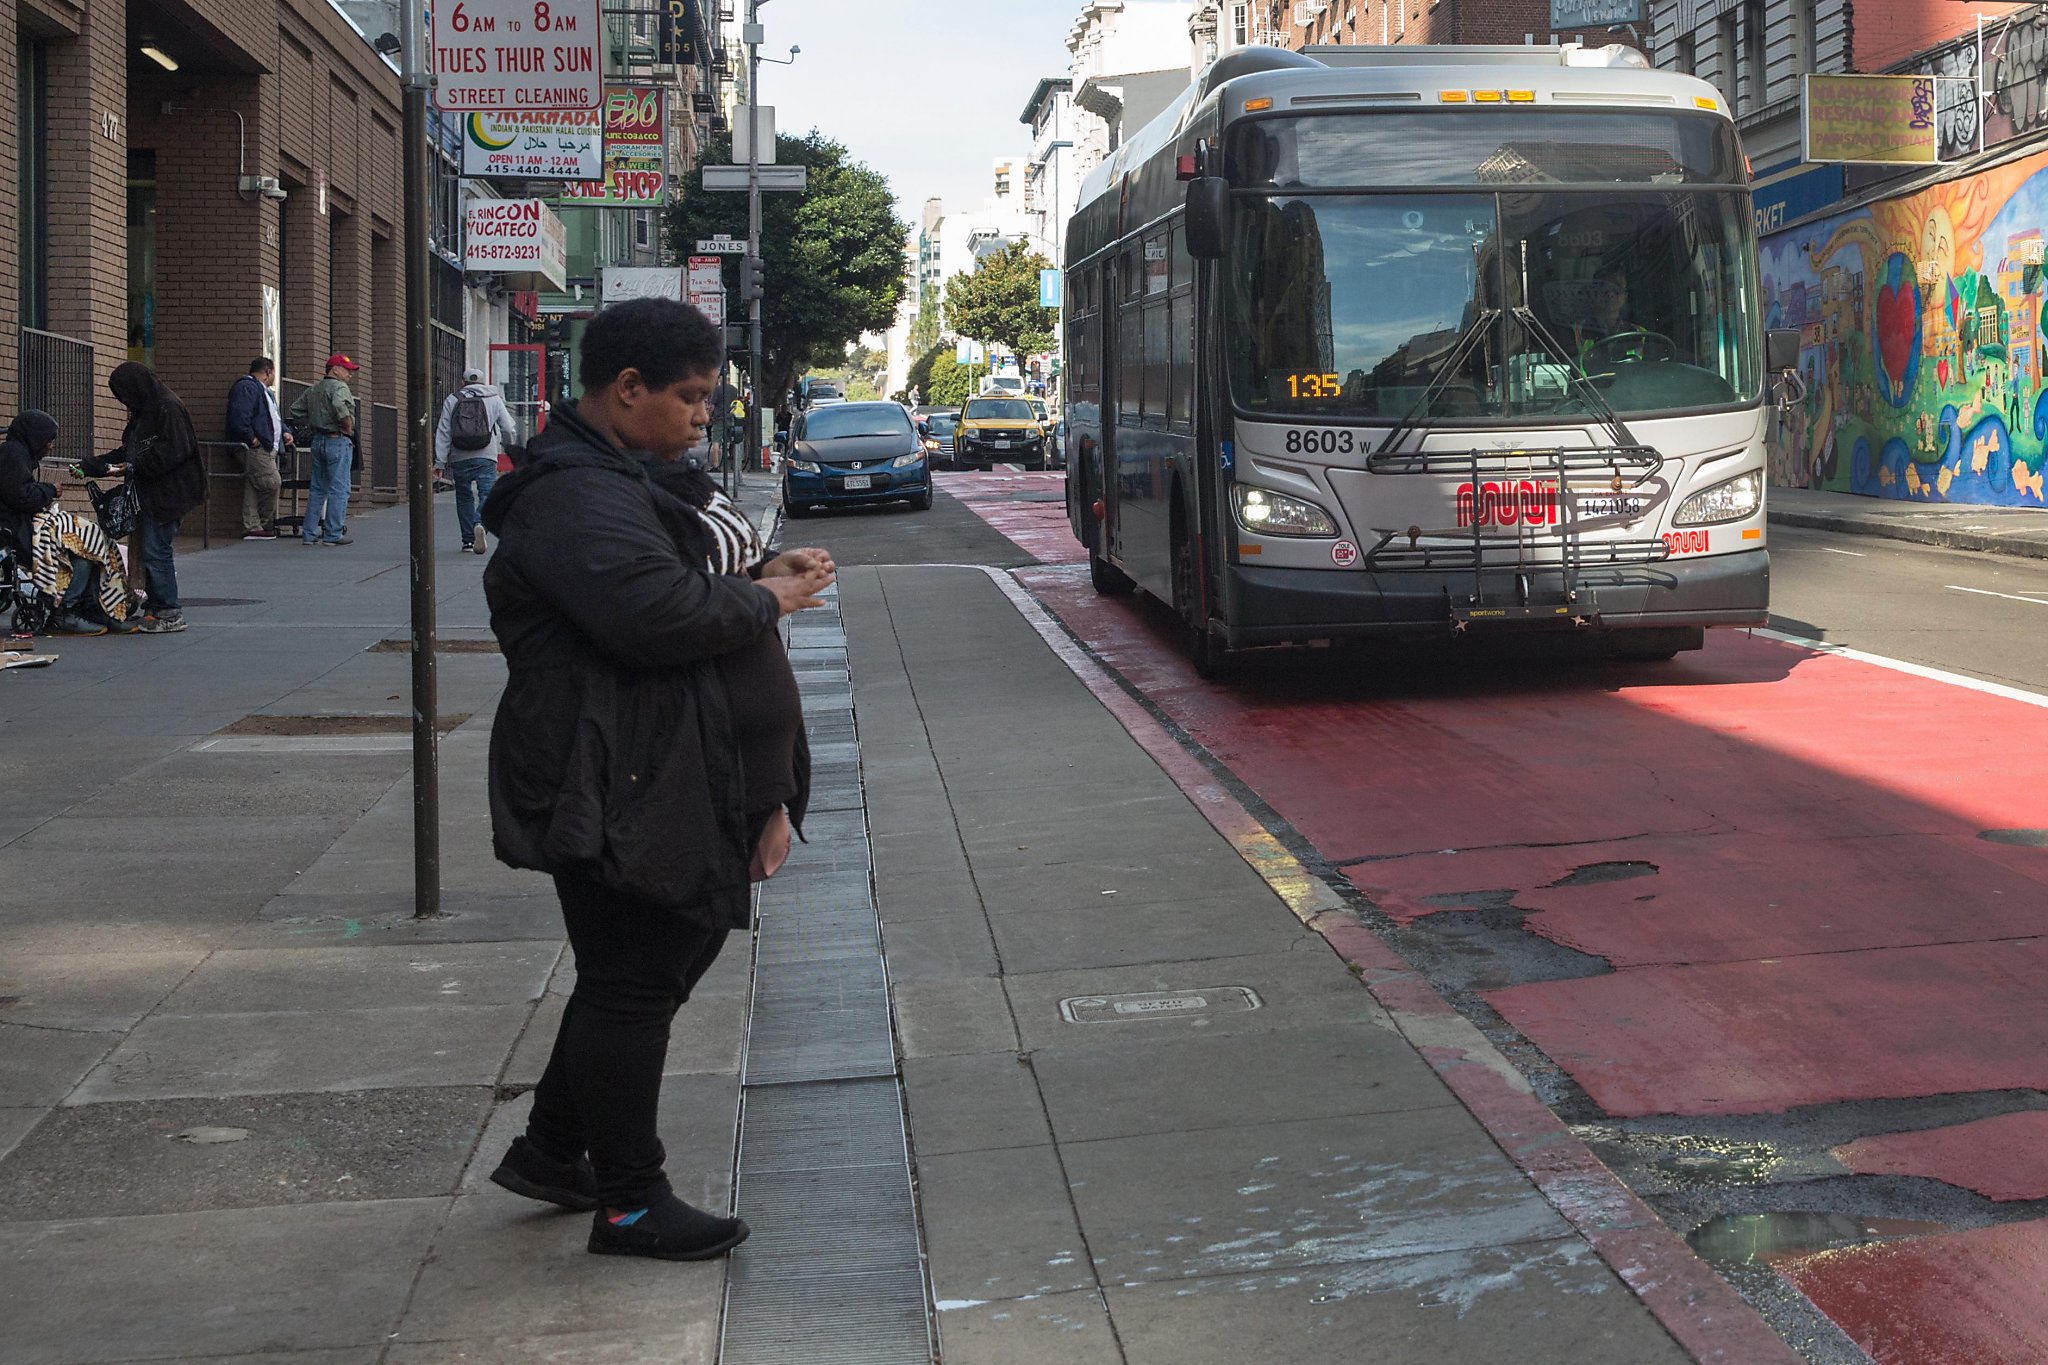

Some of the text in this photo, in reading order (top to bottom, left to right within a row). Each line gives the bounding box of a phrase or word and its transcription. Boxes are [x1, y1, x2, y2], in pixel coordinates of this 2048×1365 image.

[508, 20, 521, 32] TO
[438, 47, 592, 73] TUES THUR SUN
[448, 87, 588, 104] STREET CLEANING
[490, 124, 601, 136] INDIAN & PAKISTANI HALAL CUISINE
[488, 154, 513, 164] OPEN
[515, 155, 525, 165] 11
[527, 156, 543, 165] AM
[552, 156, 562, 166] 12
[563, 157, 578, 166] AM
[629, 161, 657, 170] WEEK
[484, 164, 581, 176] 415-440-4444
[613, 170, 662, 203] SHOP
[468, 200, 540, 220] EL RINCON
[467, 221, 537, 238] YUCATECO
[467, 244, 541, 259] 415-872-9231
[701, 242, 743, 251] JONES
[690, 295, 700, 305] NO
[1286, 373, 1342, 398] 135
[1285, 429, 1354, 454] 8603
[1584, 497, 1640, 517] 1421058
[1469, 609, 1506, 617] sportworks
